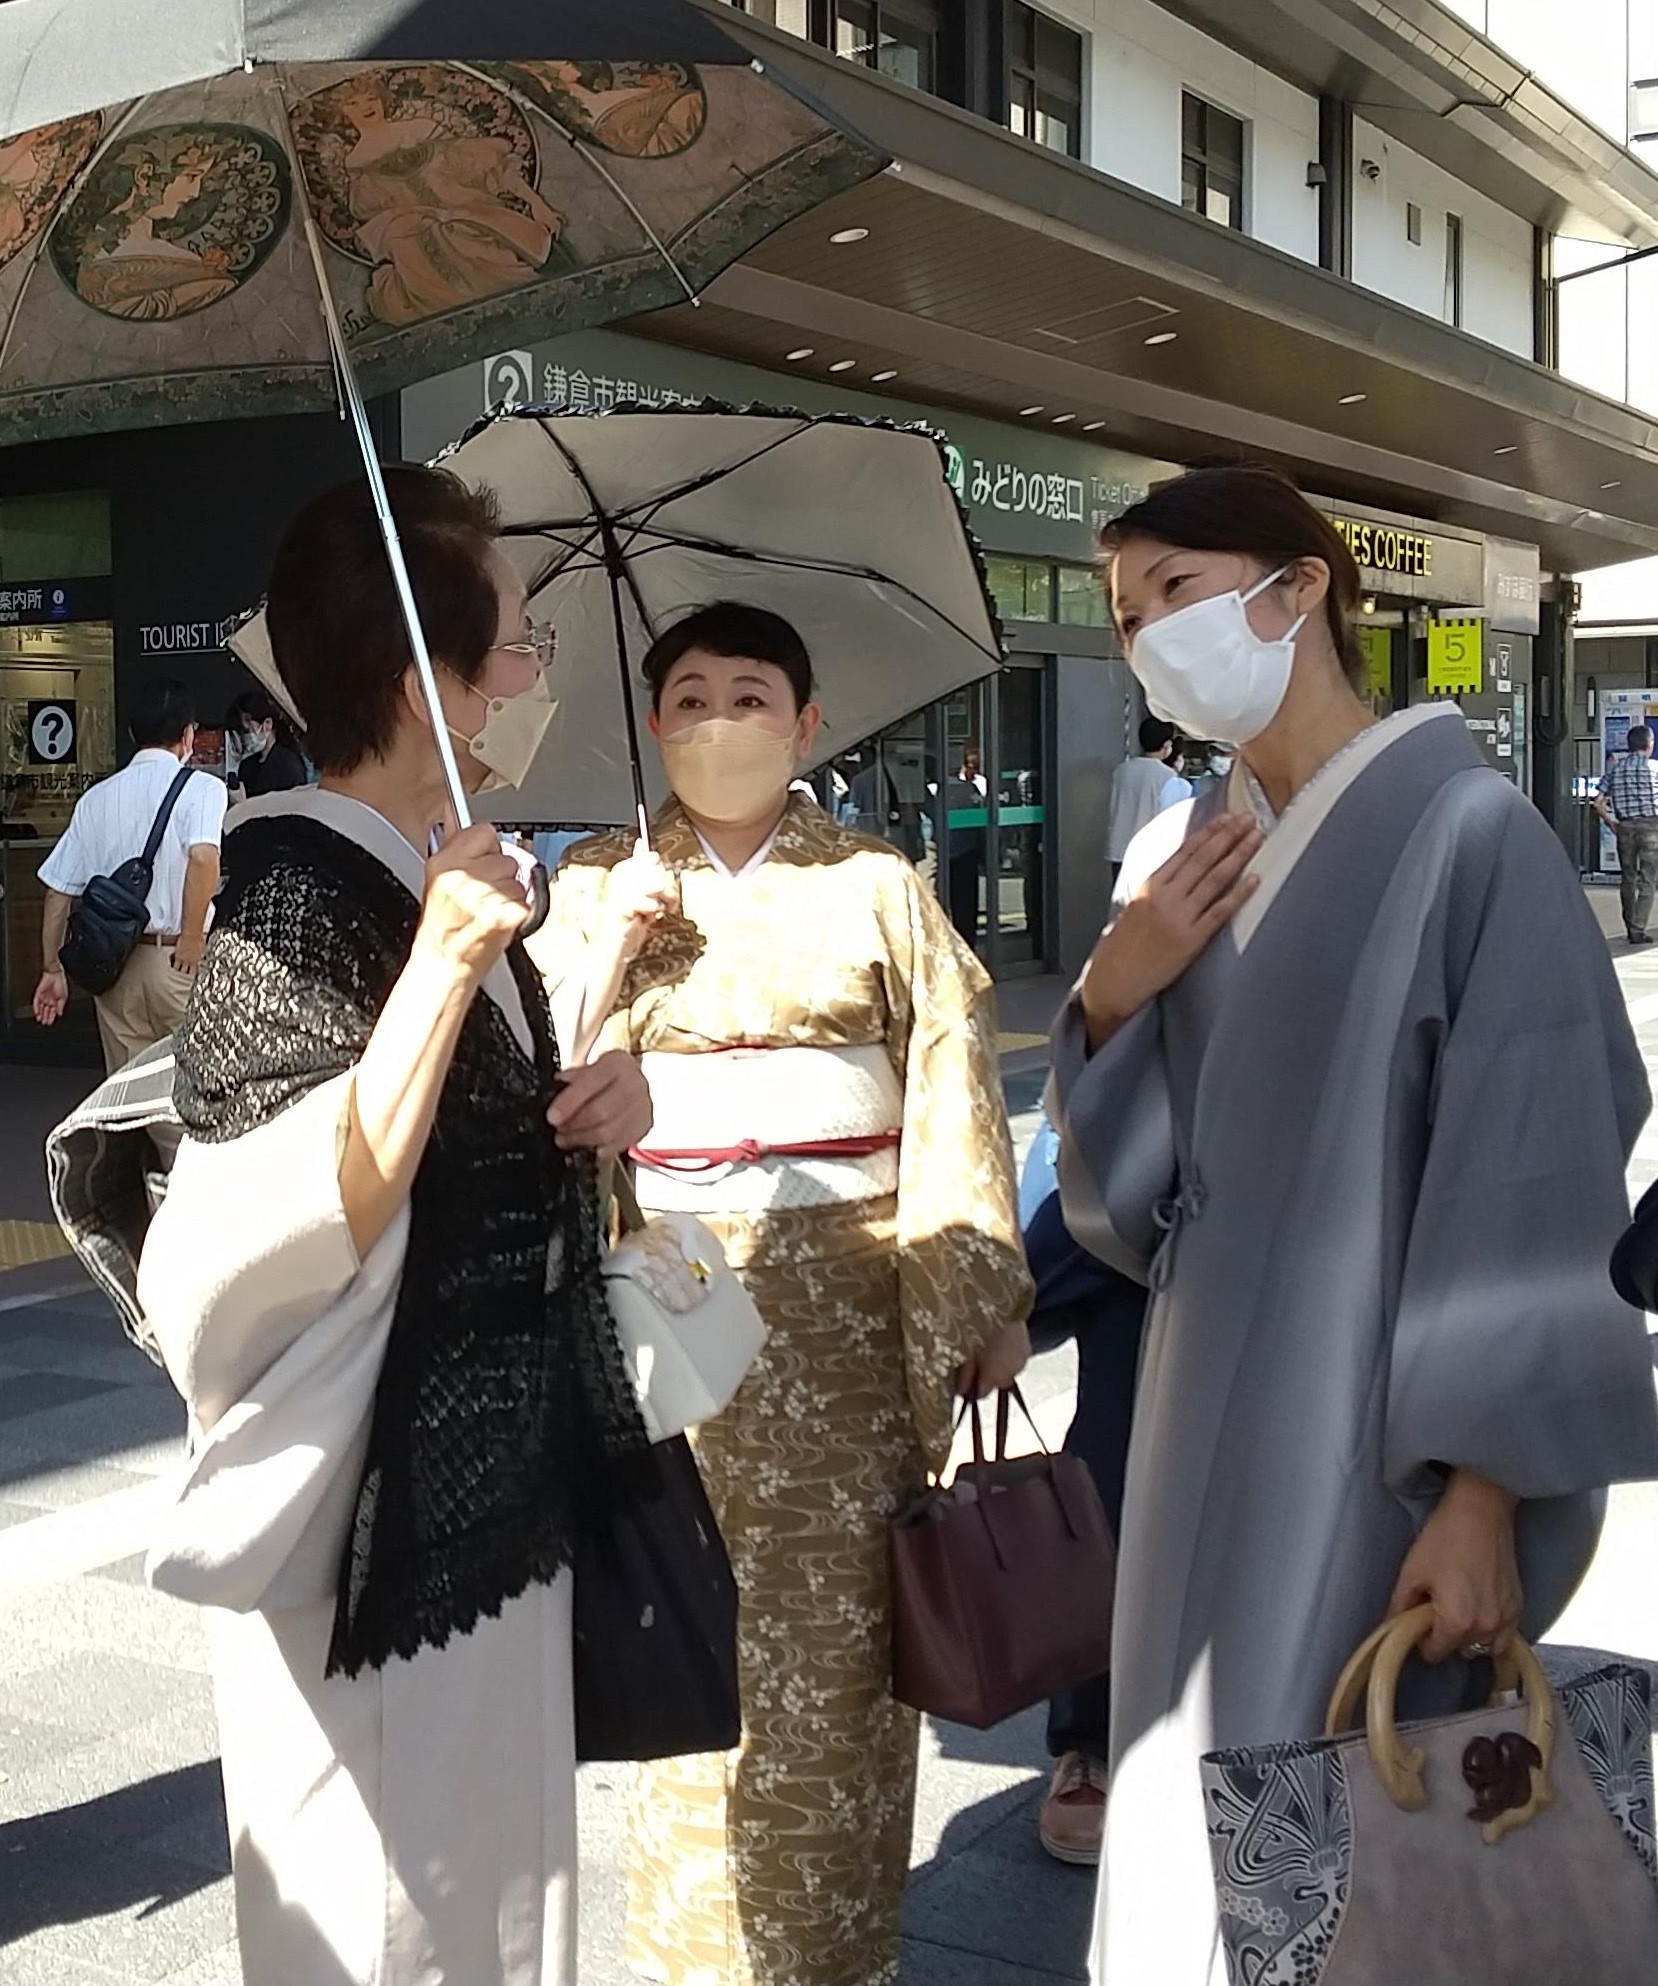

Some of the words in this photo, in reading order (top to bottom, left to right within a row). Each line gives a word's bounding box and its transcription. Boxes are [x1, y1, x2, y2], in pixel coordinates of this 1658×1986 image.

[970, 459, 1084, 524] みどりの窓口
[1373, 528, 1433, 576] COFFEE
[139, 622, 211, 650] TOURIST
[1445, 633, 1466, 663] 5
